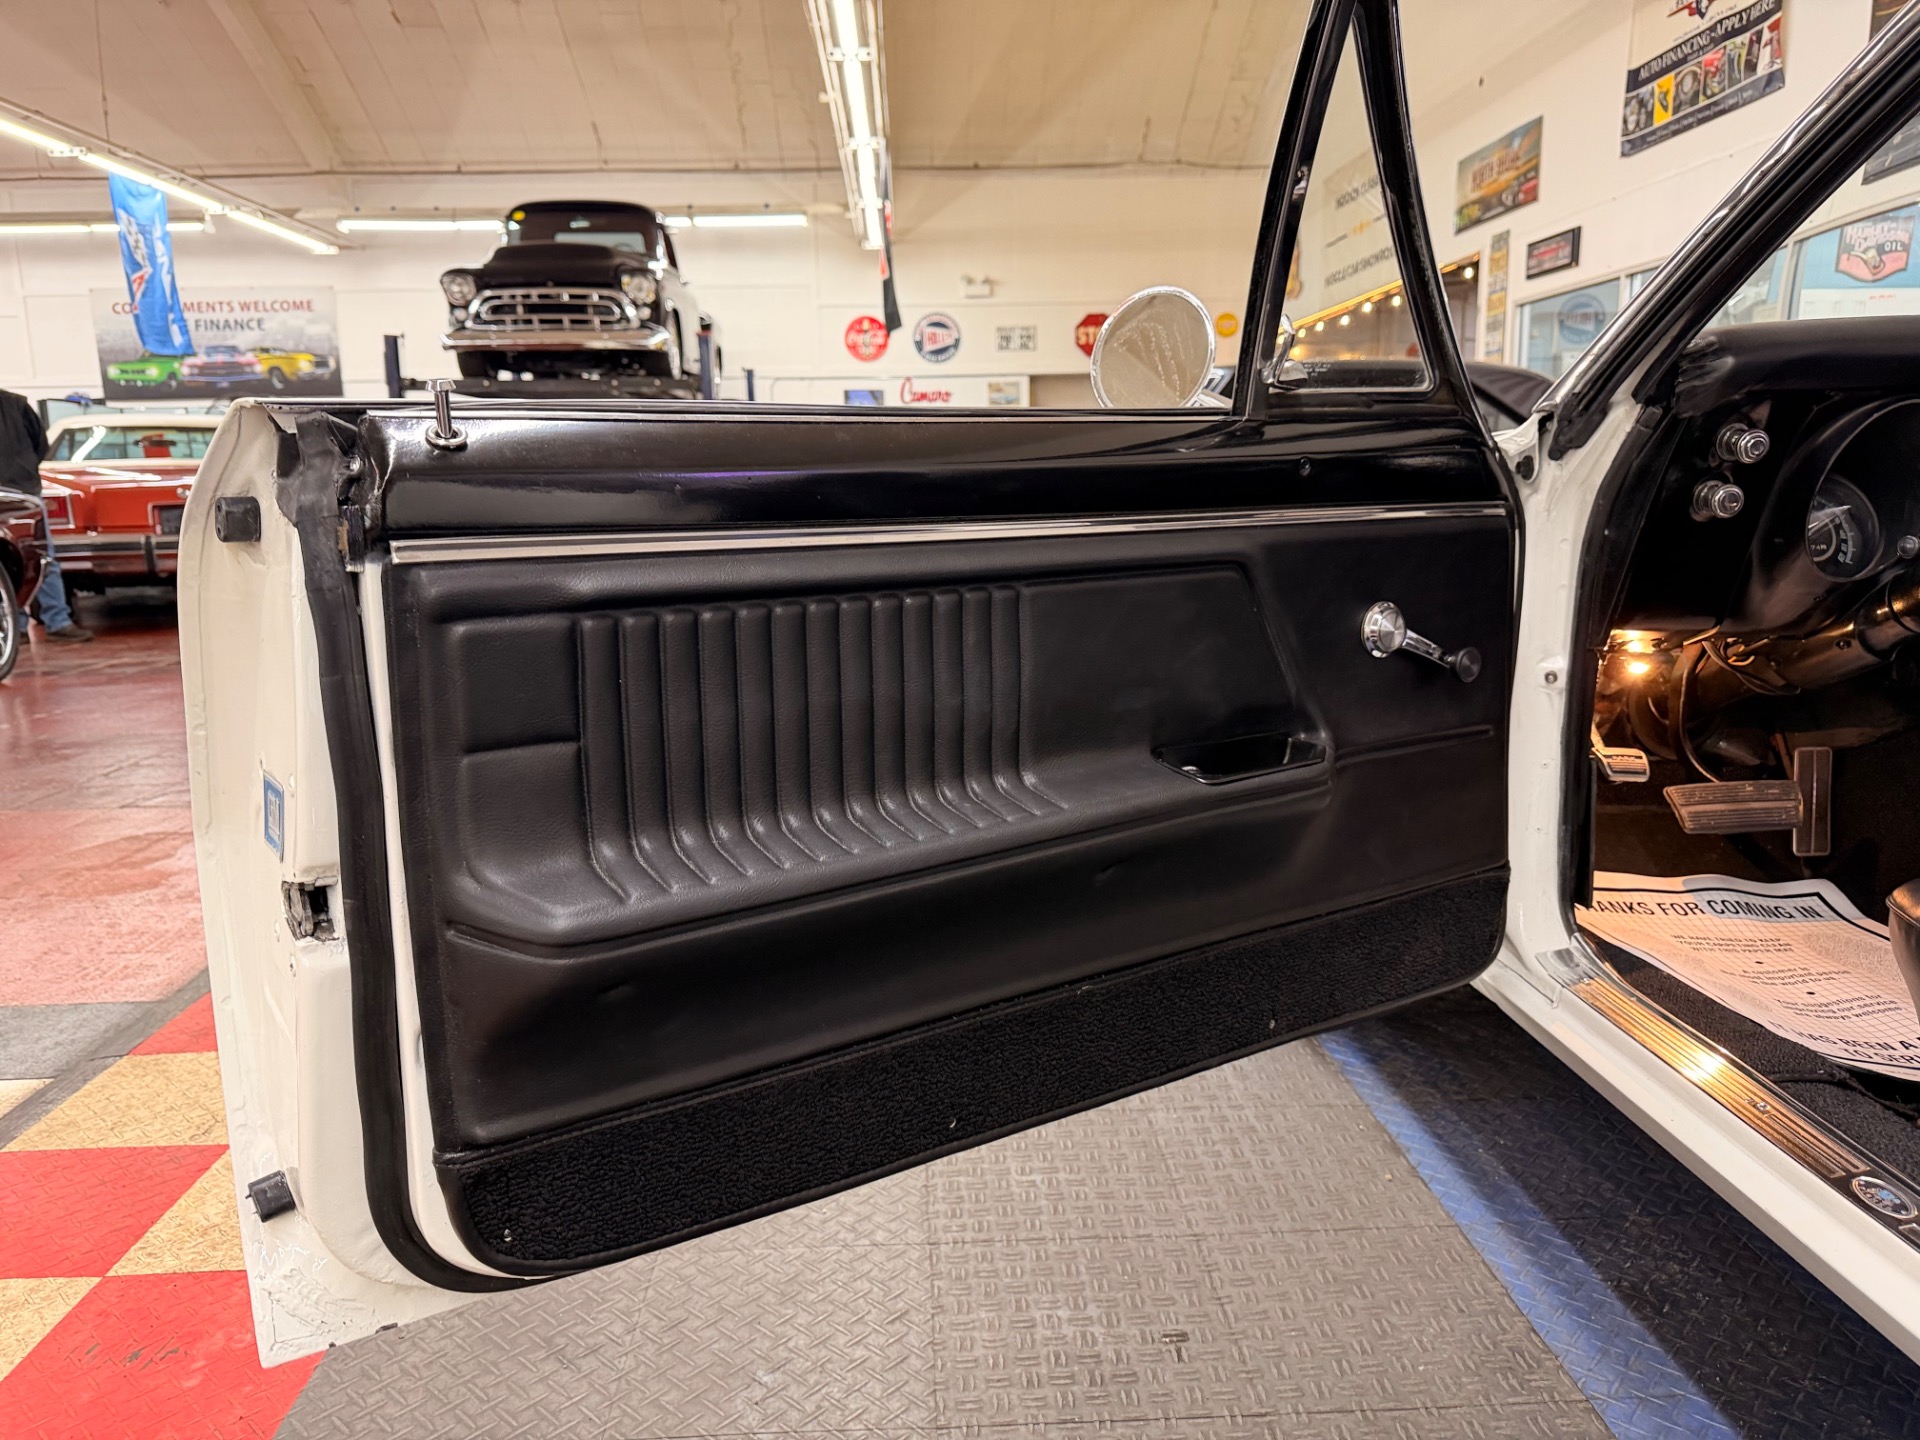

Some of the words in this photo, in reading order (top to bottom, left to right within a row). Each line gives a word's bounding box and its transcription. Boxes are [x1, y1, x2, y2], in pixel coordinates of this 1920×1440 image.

[1884, 241, 1904, 252] OIL
[238, 299, 314, 313] WELCOME
[194, 317, 266, 332] FINANCE
[900, 376, 952, 405] Camaro
[1656, 901, 1706, 916] FOR
[1706, 899, 1796, 919] COMING
[1793, 905, 1825, 919] IN
[1764, 971, 1814, 981] important
[1800, 995, 1866, 1008] suggestions
[1836, 1005, 1856, 1013] our
[1856, 1000, 1898, 1009] service
[1837, 1037, 1898, 1052] BEEN
[1898, 1039, 1919, 1051] A
[1839, 1047, 1874, 1060] TO
